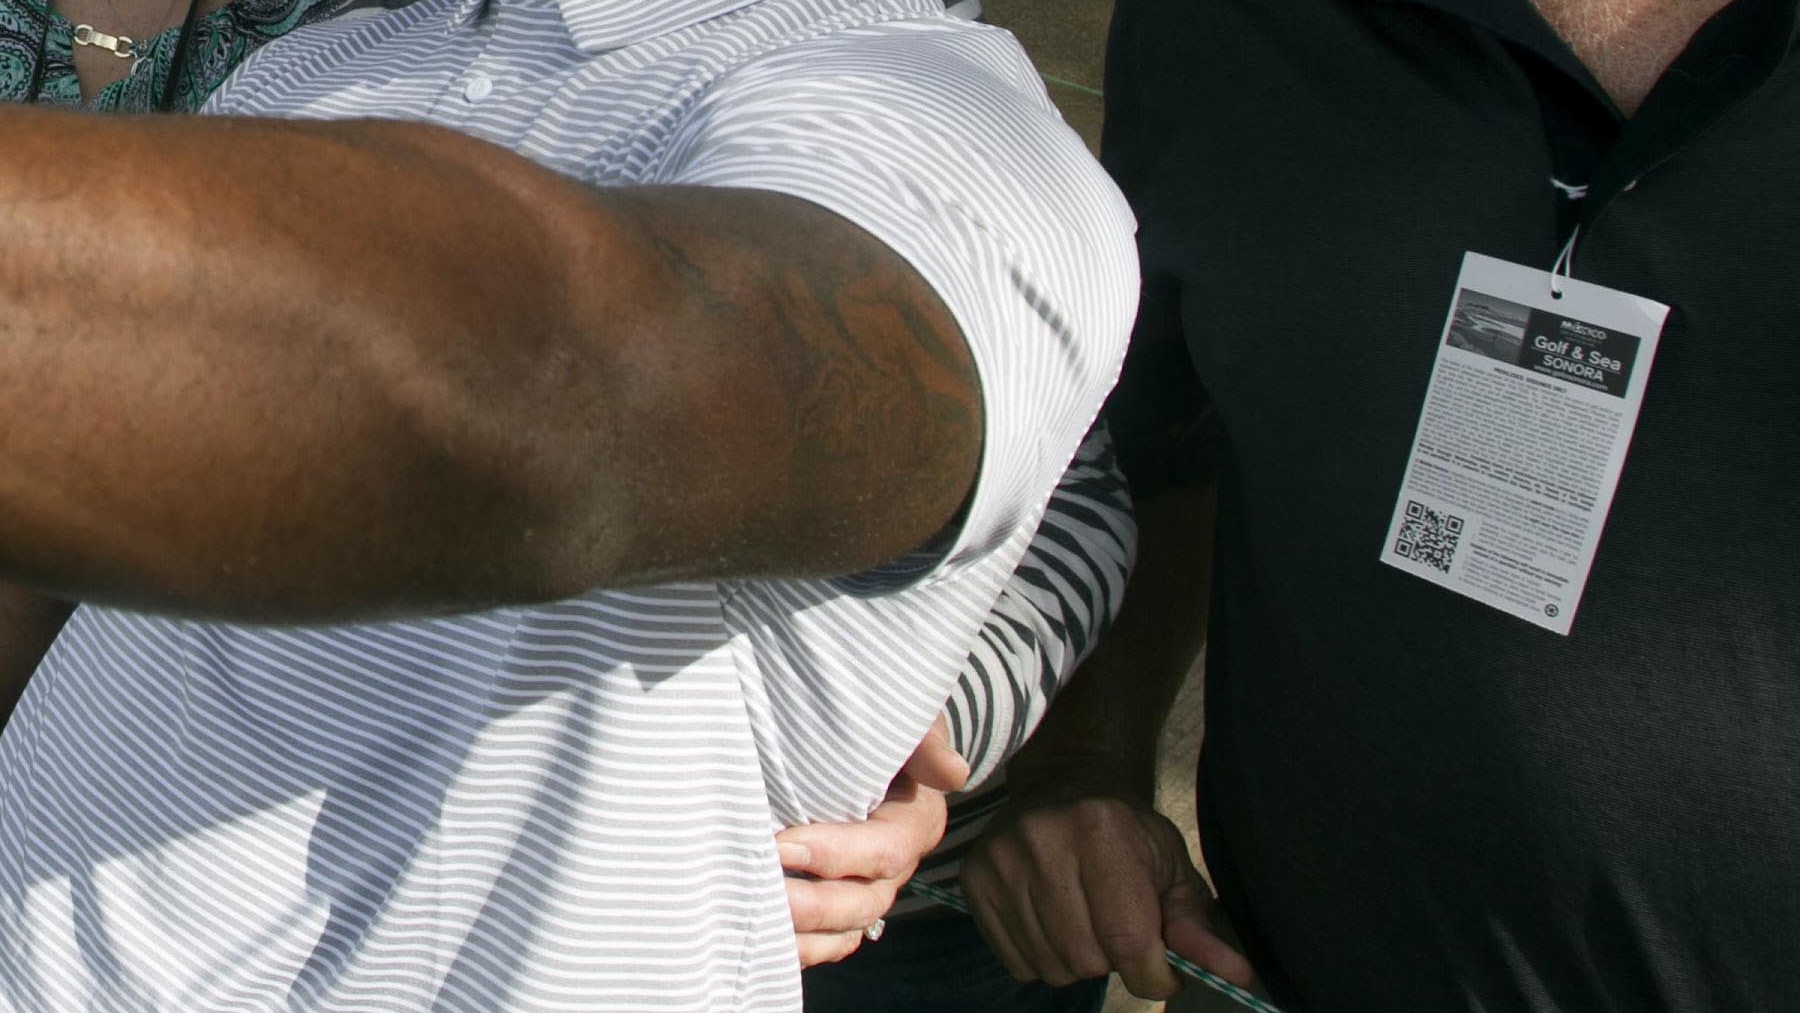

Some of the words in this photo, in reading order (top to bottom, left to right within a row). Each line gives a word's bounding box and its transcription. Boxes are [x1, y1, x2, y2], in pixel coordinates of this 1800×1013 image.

[1534, 335, 1571, 355] Golf
[1571, 346, 1585, 361] &
[1588, 350, 1622, 372] Sea
[1542, 354, 1605, 382] SONORA
